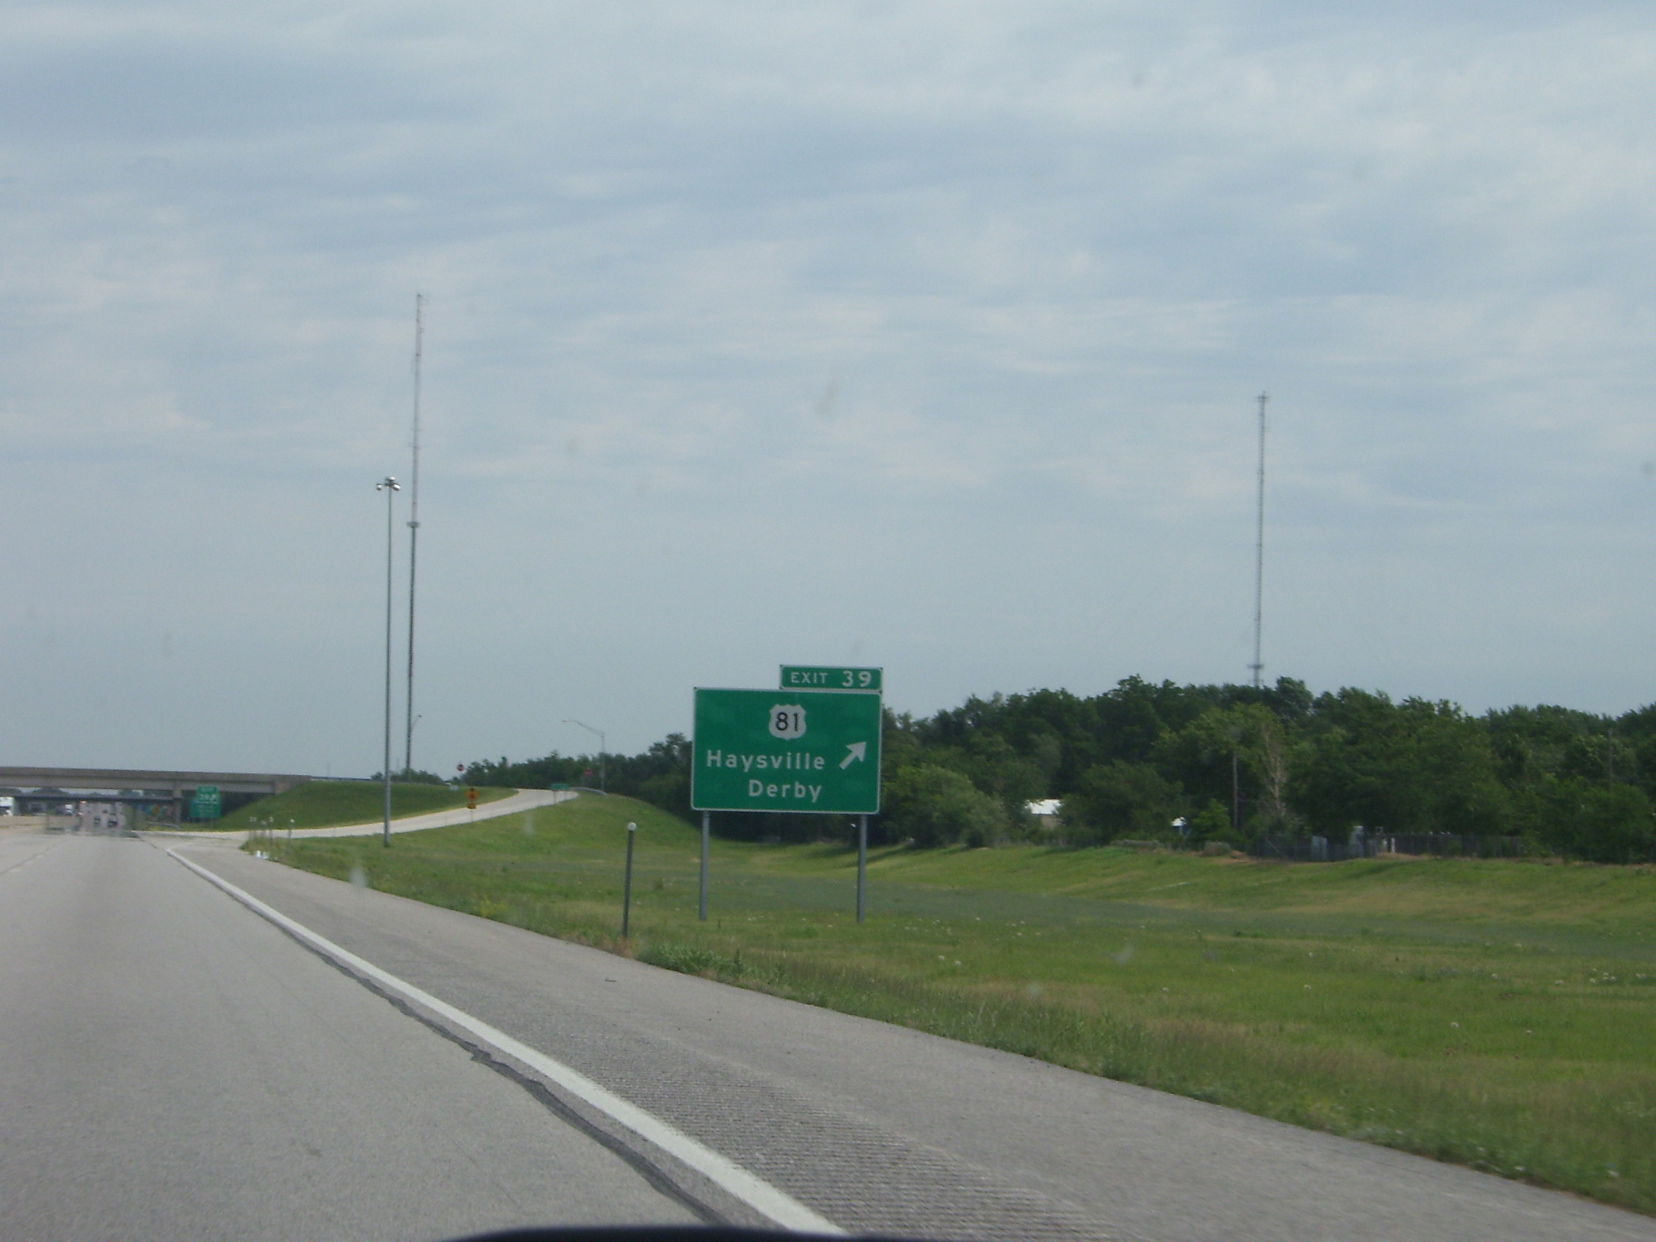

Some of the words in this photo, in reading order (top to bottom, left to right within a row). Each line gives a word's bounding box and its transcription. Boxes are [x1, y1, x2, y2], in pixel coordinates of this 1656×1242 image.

[791, 671, 829, 684] EXIT
[842, 670, 872, 687] 39
[775, 712, 798, 732] 81
[706, 749, 825, 772] Haysville
[748, 779, 822, 803] Derby
